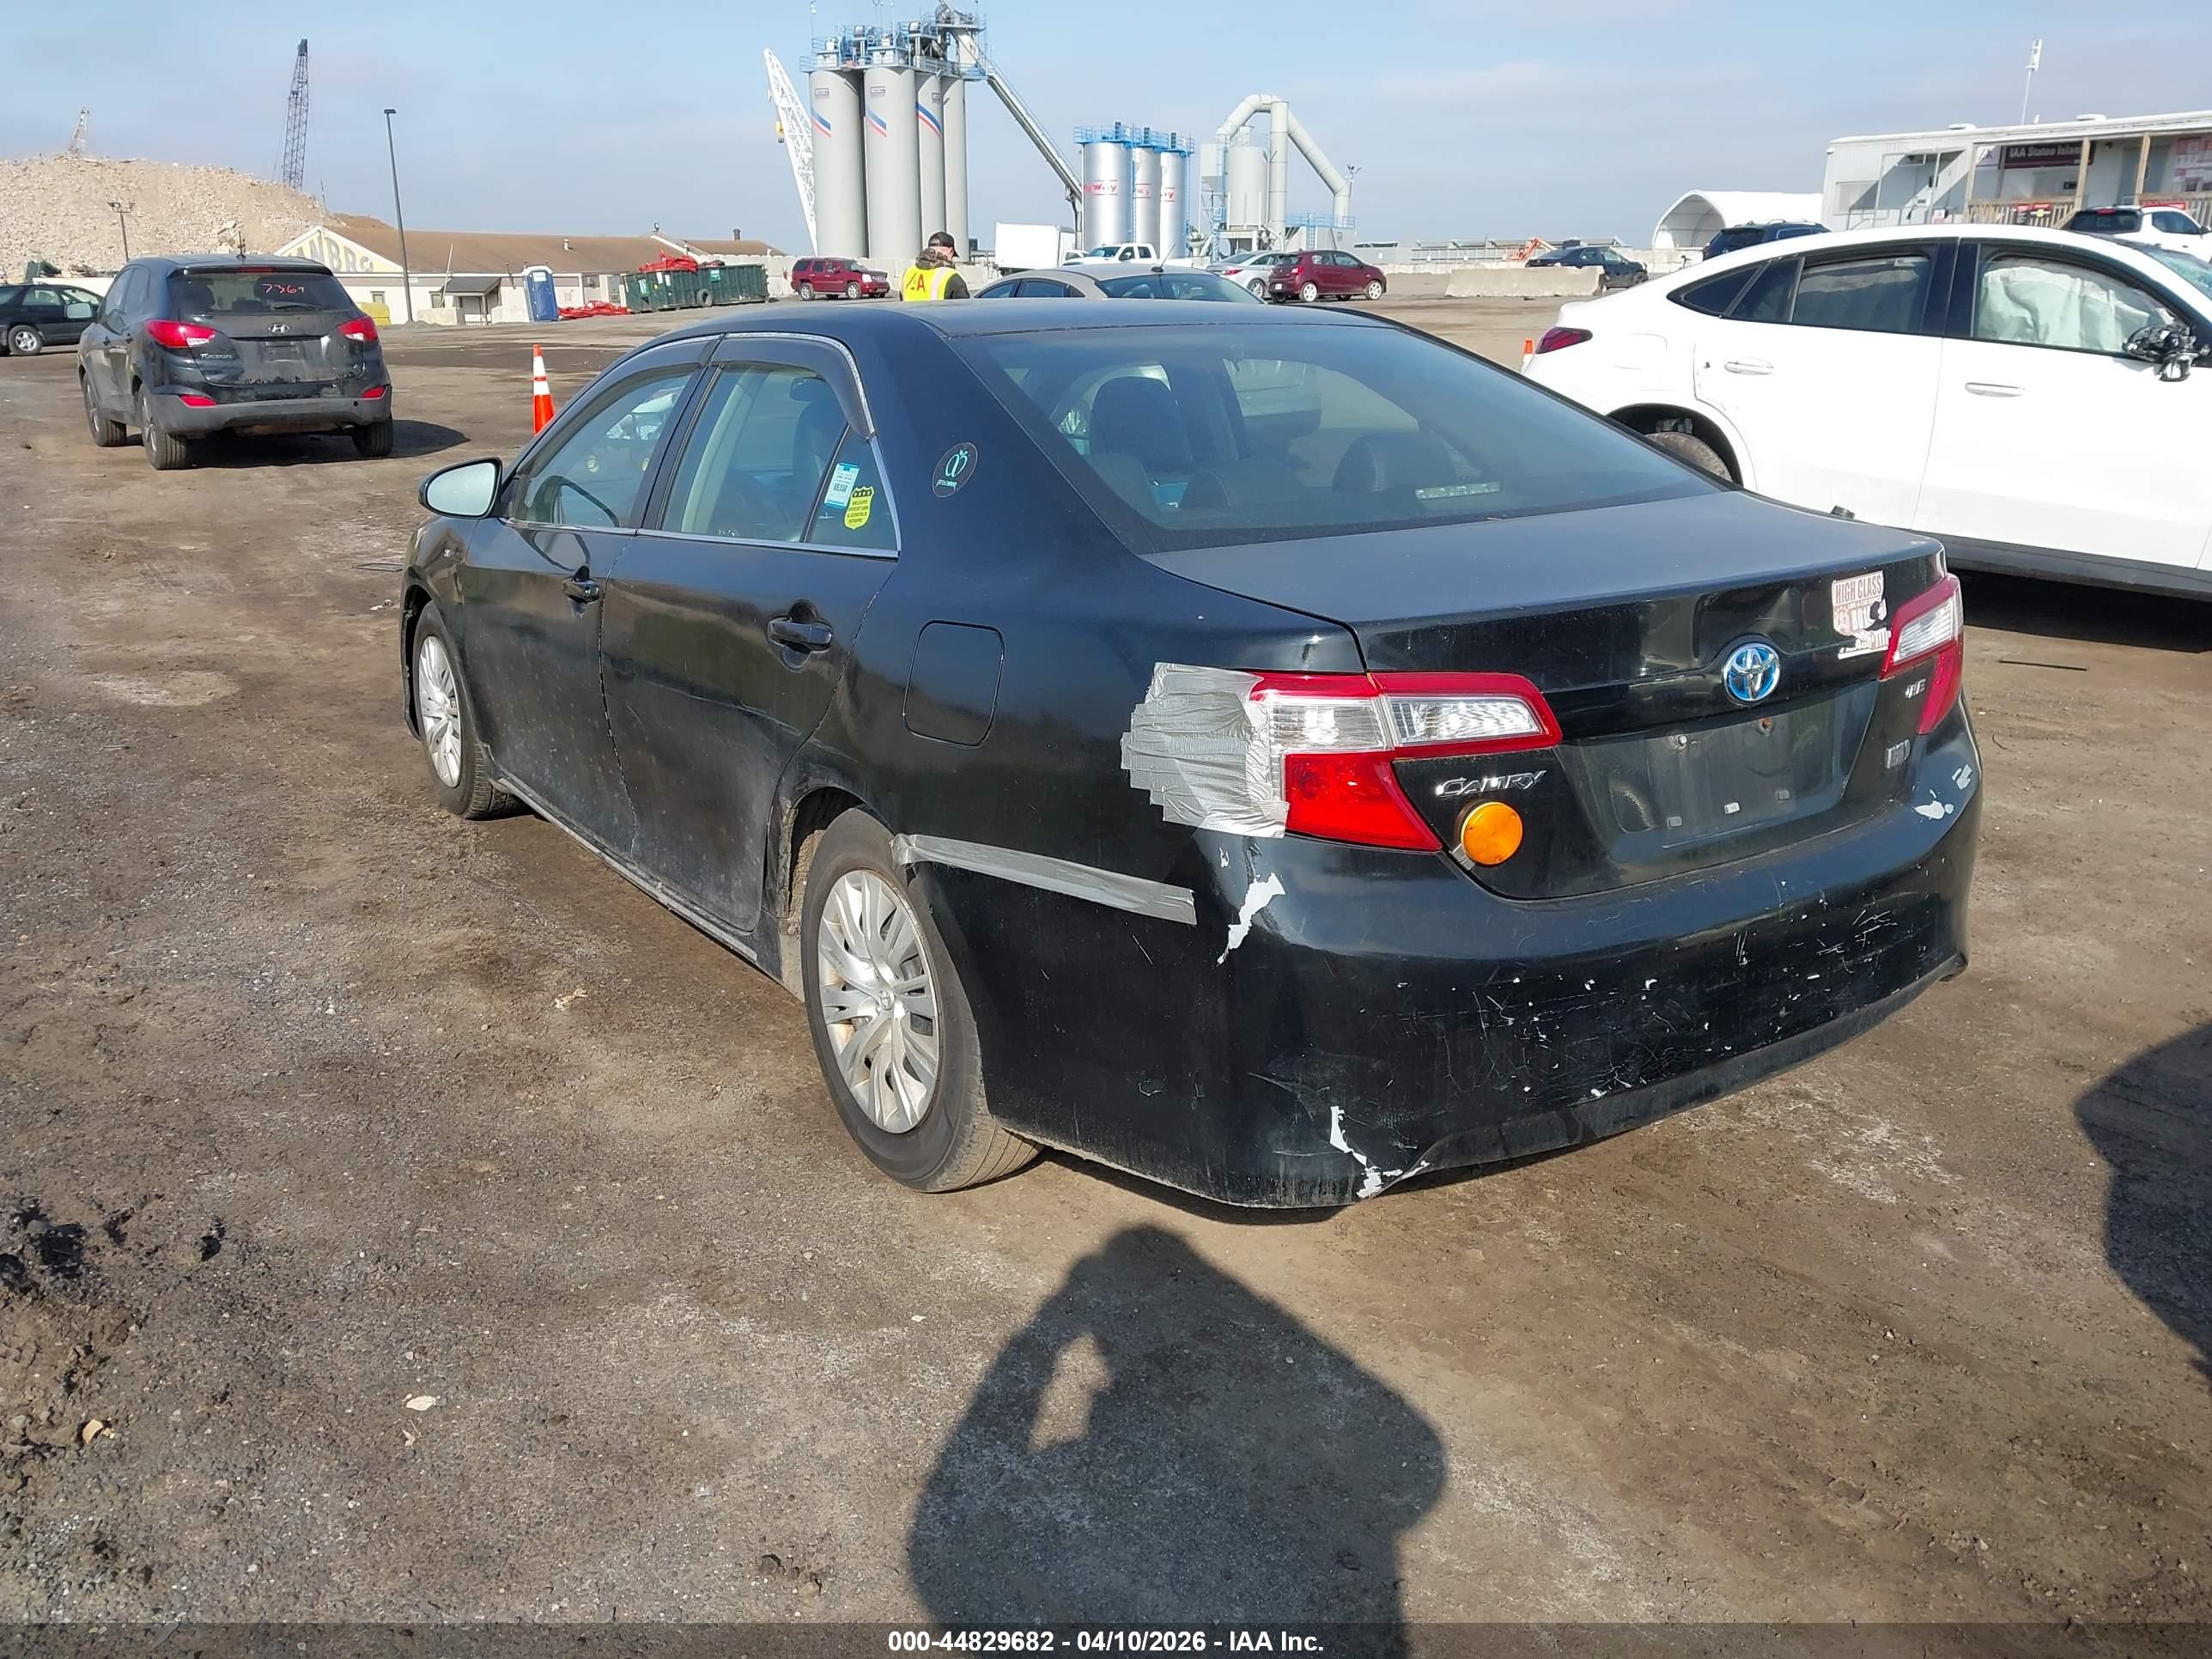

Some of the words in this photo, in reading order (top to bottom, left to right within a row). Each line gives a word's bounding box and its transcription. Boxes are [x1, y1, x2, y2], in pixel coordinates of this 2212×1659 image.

[2057, 142, 2082, 155] Islan
[261, 283, 305, 295] 7369
[1835, 581, 1856, 605] HIGH
[1857, 574, 1882, 599] CLASS
[1436, 770, 1547, 798] CAMRY
